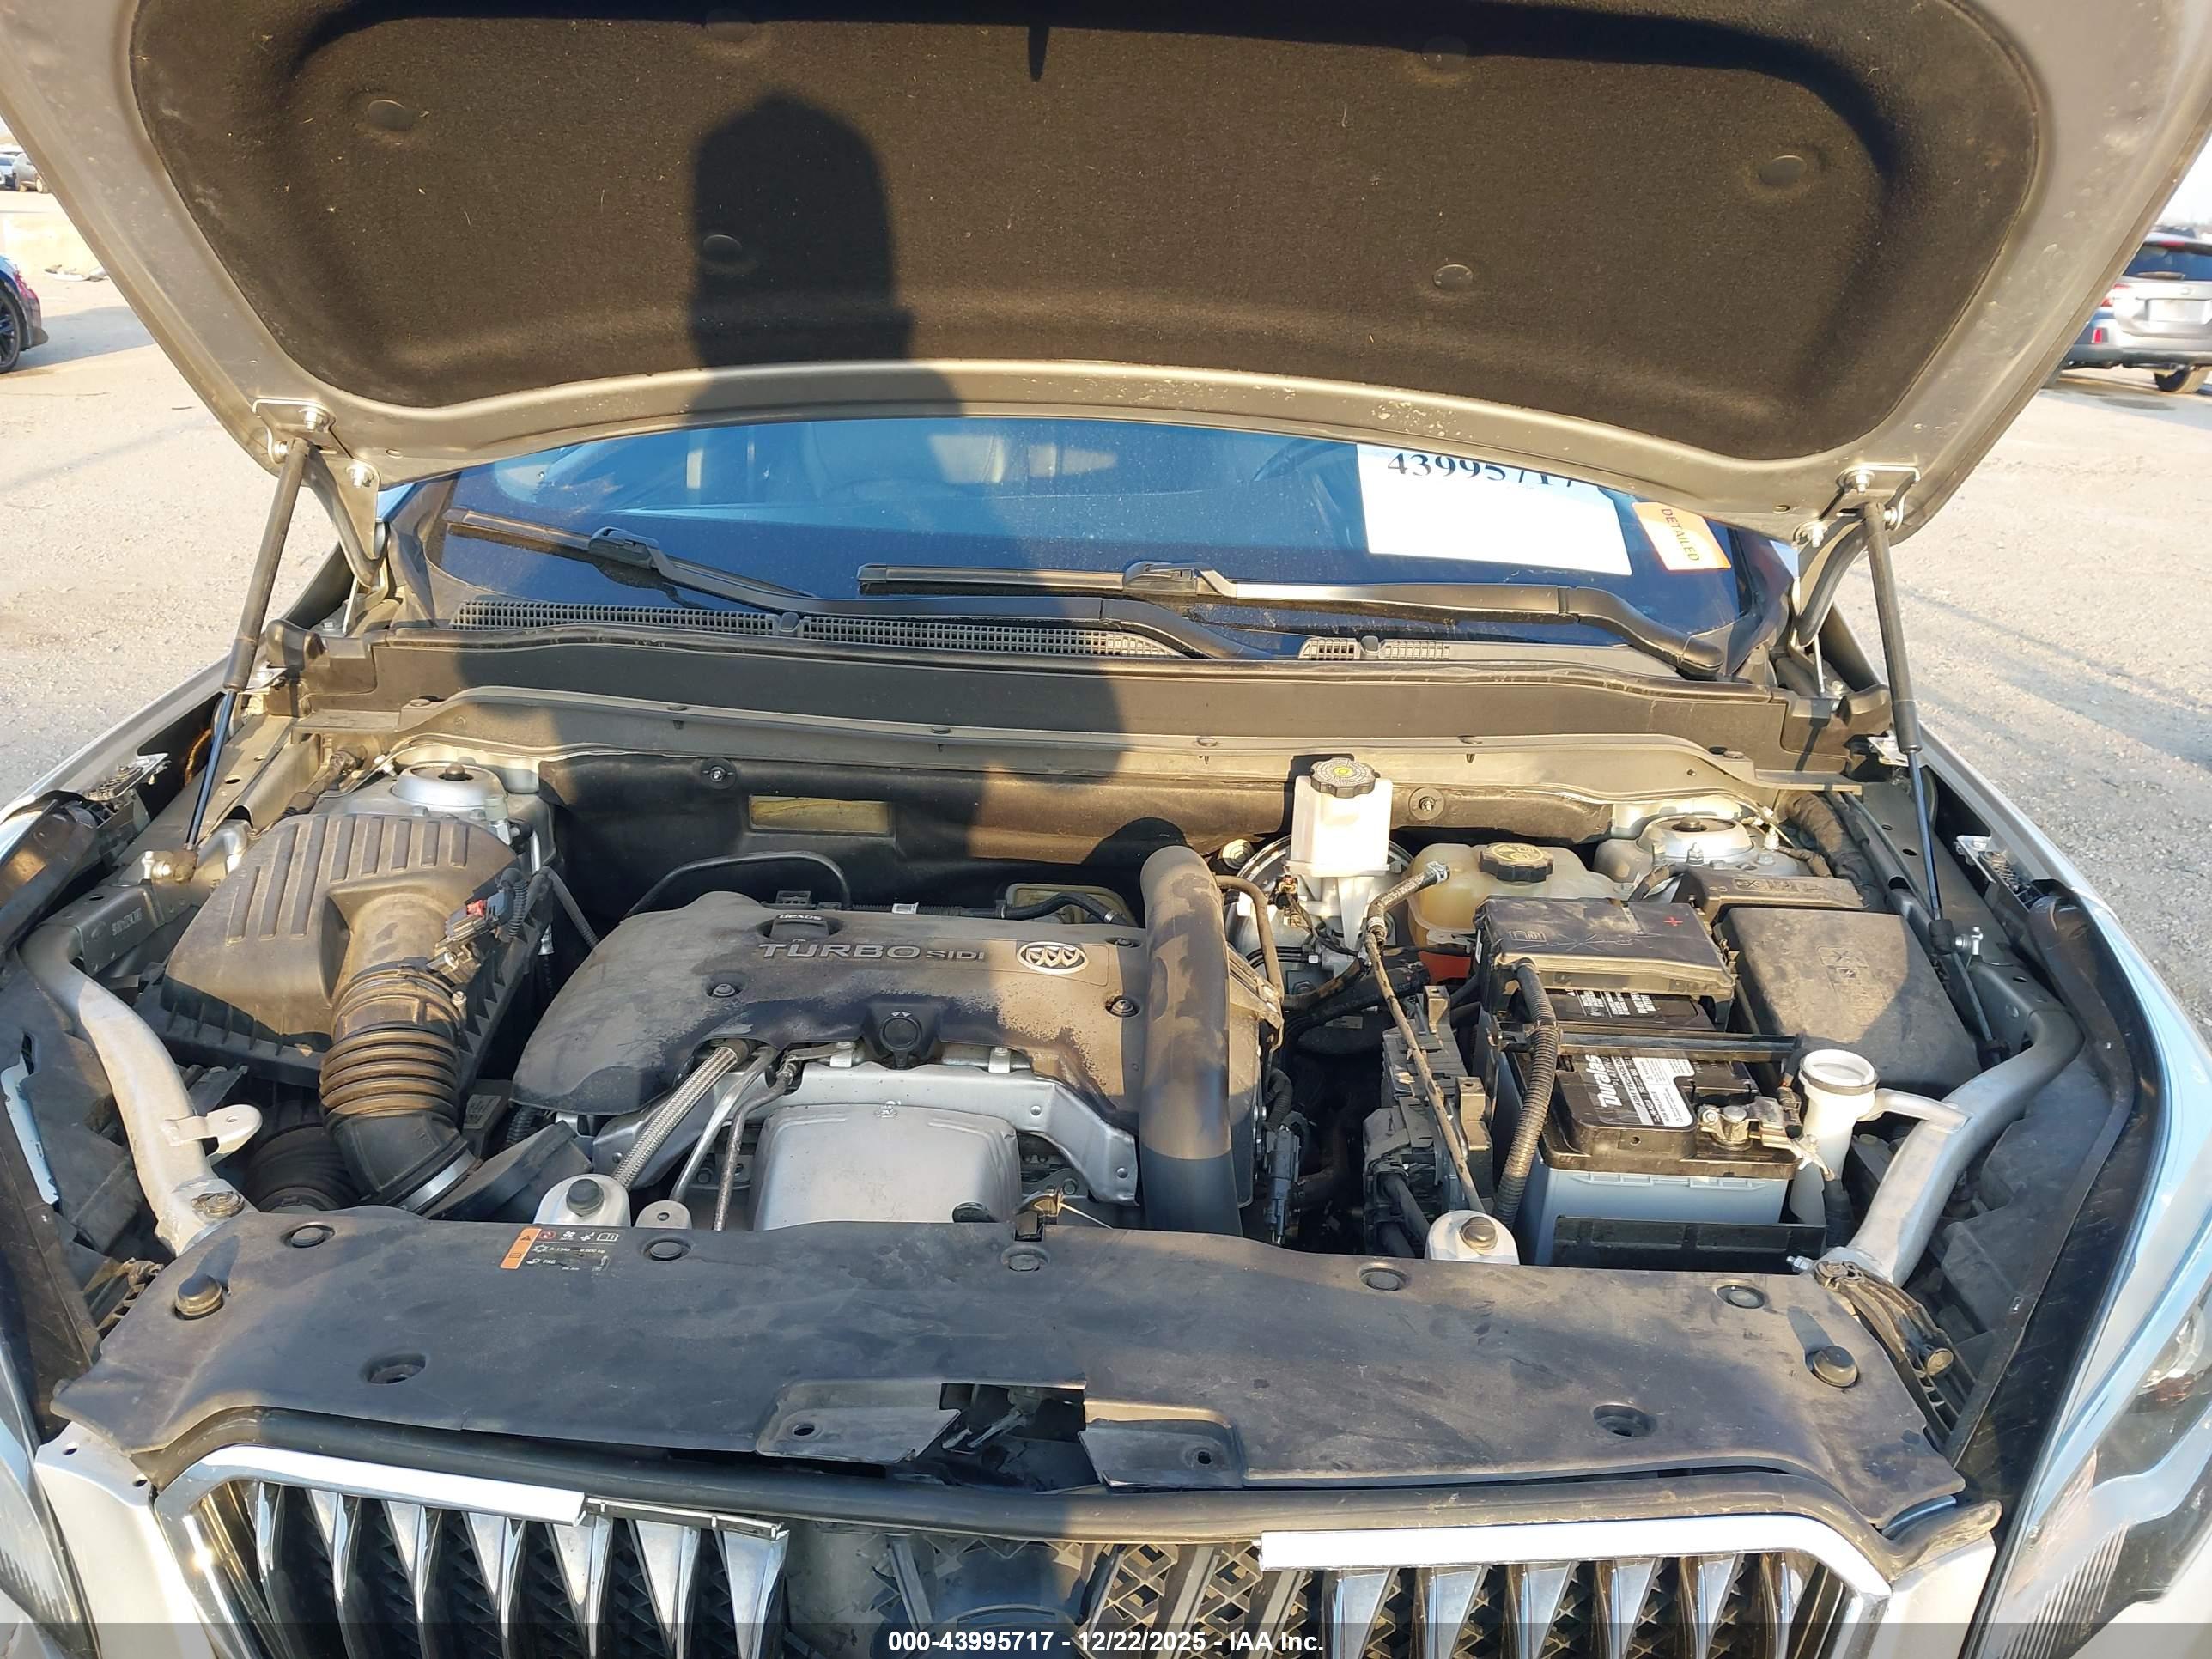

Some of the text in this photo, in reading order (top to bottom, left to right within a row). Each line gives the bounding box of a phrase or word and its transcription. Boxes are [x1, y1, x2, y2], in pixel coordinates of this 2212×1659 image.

[1662, 508, 1700, 561] DETAILED
[759, 943, 985, 960] TURBO SIDI
[1585, 1054, 1622, 1108] Duralas
[1600, 1055, 1622, 1086] PLATINU
[1612, 1056, 1637, 1091] TECHNOLOG
